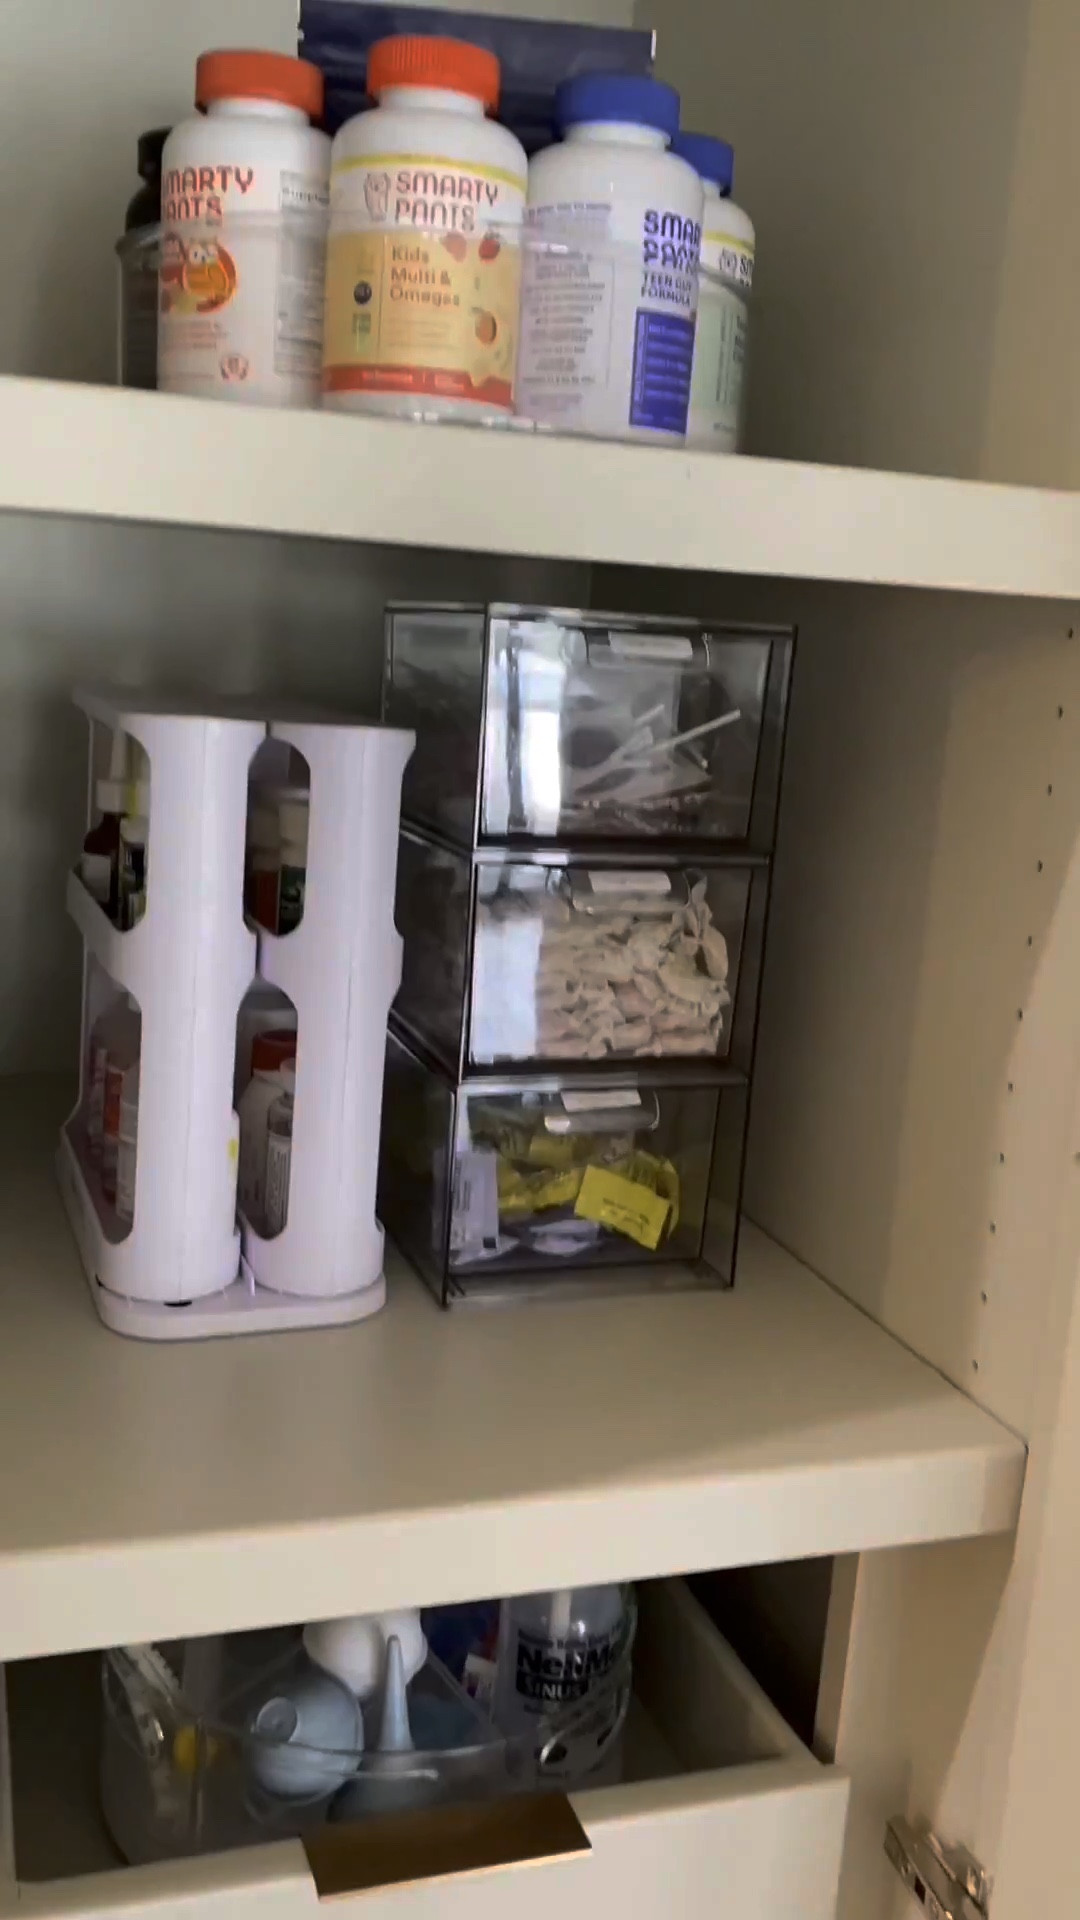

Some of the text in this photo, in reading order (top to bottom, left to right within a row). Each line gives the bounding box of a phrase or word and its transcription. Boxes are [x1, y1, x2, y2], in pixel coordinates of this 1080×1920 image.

[163, 166, 254, 194] MARTY
[396, 171, 498, 206] SMARTY
[162, 196, 223, 227] ANTS
[395, 199, 475, 231] PANTS
[392, 245, 430, 264] Kids
[391, 267, 436, 285] Multi
